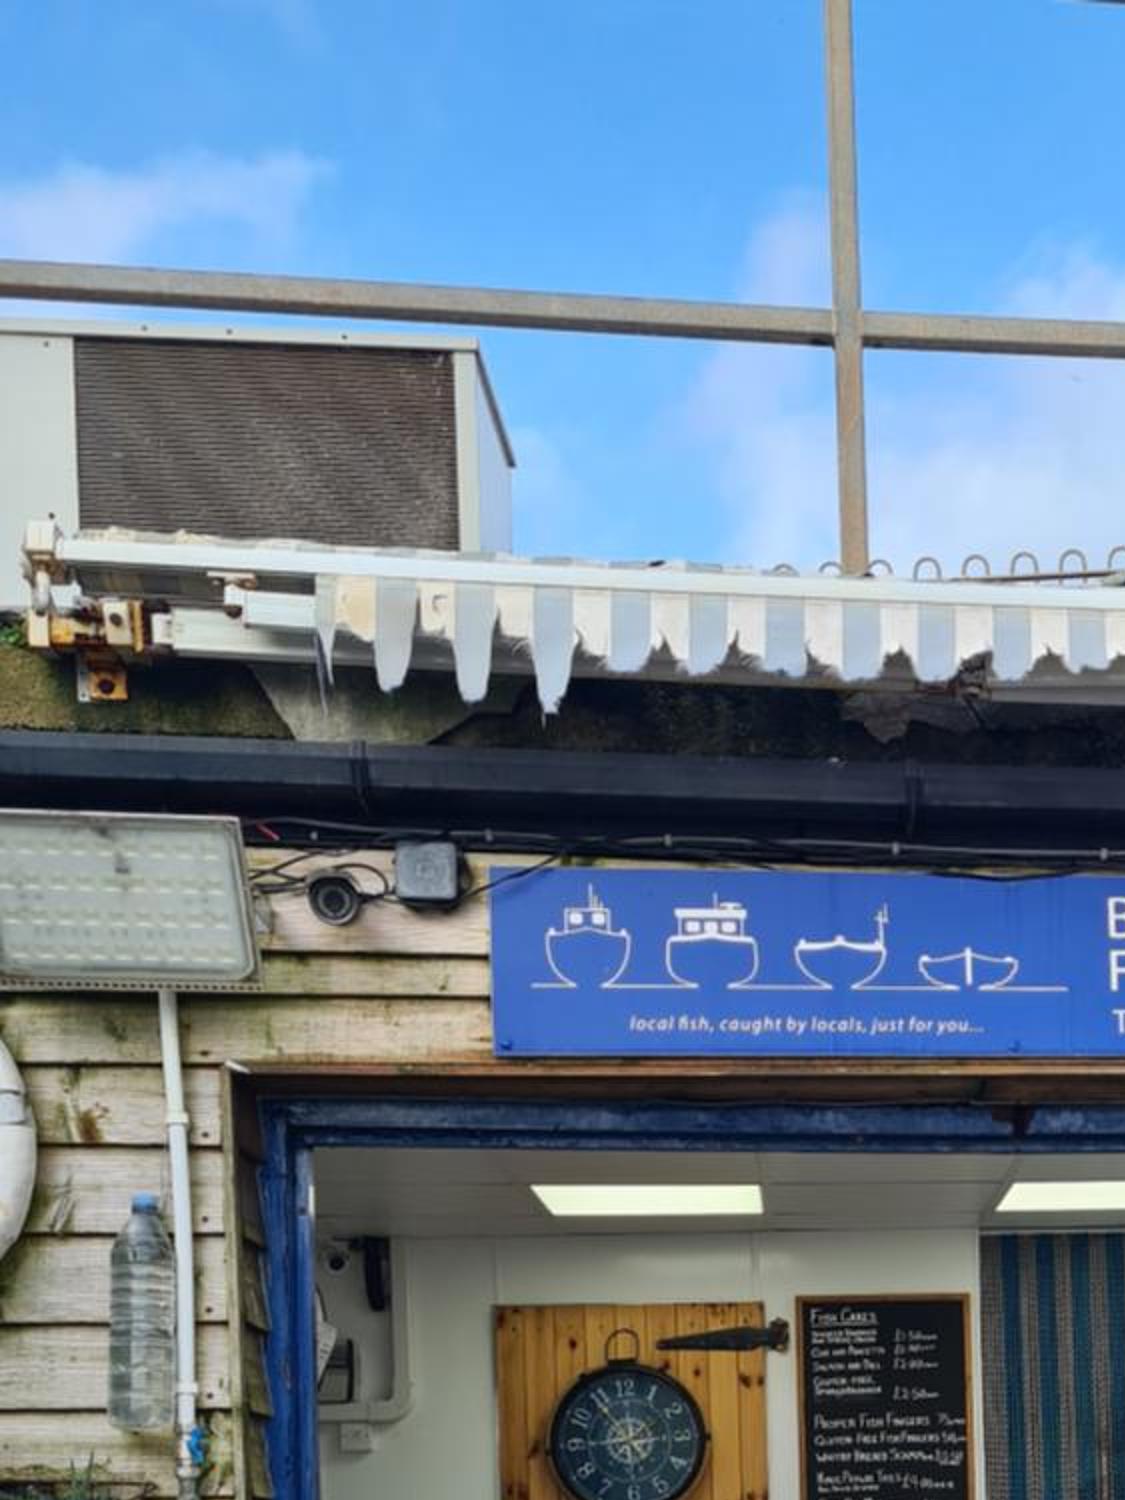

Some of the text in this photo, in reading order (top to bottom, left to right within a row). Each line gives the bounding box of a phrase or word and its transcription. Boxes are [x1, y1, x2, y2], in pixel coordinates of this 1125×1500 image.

[630, 1016, 674, 1032] local
[677, 1016, 715, 1034] fish,
[720, 1016, 782, 1036] caught
[787, 1016, 806, 1036] by
[810, 1016, 867, 1034] locals,
[870, 1016, 903, 1036] just
[908, 1016, 933, 1032] for
[615, 1379, 635, 1398] 12
[590, 1387, 610, 1411] 11
[570, 1407, 592, 1428] 10
[664, 1401, 683, 1419] 2
[567, 1437, 587, 1452] 9
[674, 1429, 691, 1442] 3
[576, 1461, 597, 1479] 8
[670, 1455, 688, 1470] 4
[627, 1484, 641, 1500] 6
[652, 1475, 669, 1493] 5
